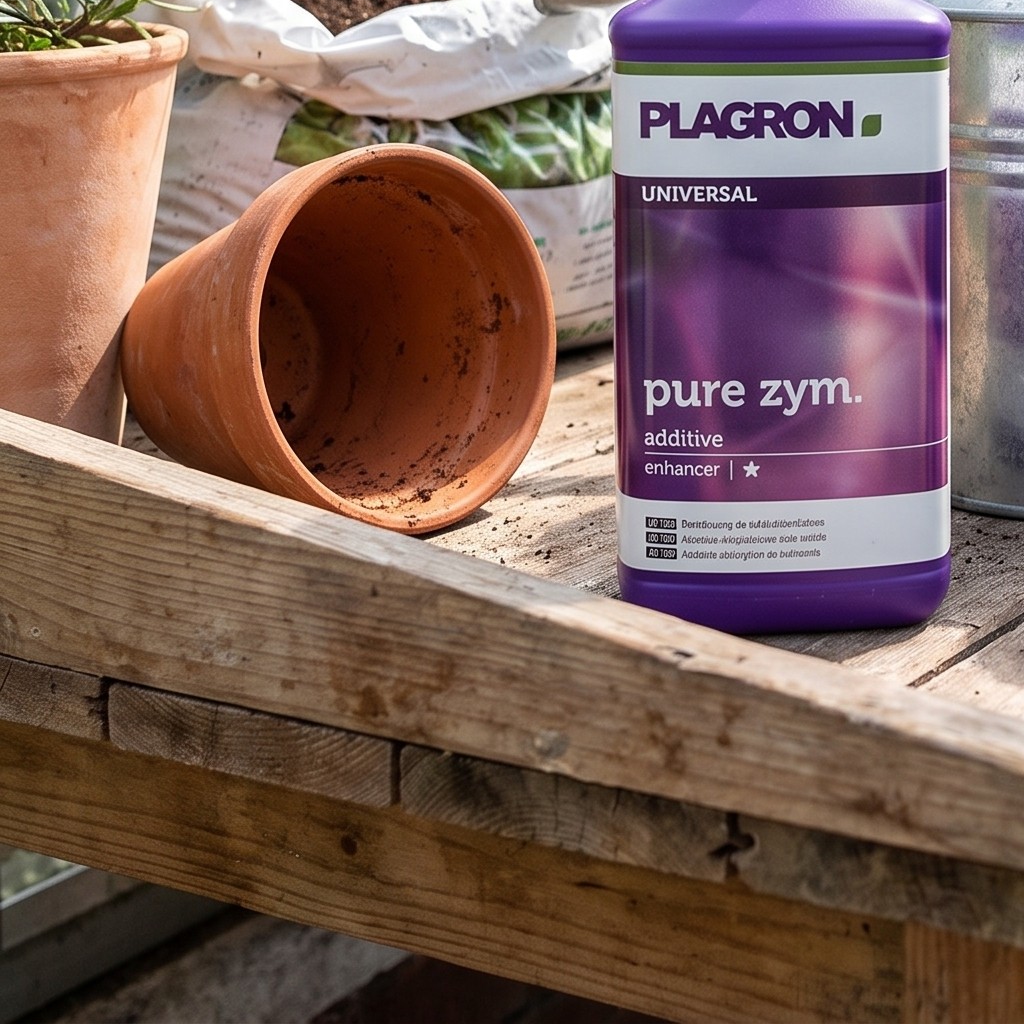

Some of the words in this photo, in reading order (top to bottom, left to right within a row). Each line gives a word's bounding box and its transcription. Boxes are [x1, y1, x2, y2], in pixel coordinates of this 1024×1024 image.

[640, 100, 854, 139] PLAGRON
[641, 185, 758, 203] UNIVERSAL
[643, 379, 746, 416] pure
[759, 377, 863, 417] zym.
[644, 428, 724, 448] additive
[644, 460, 721, 477] enhancer
